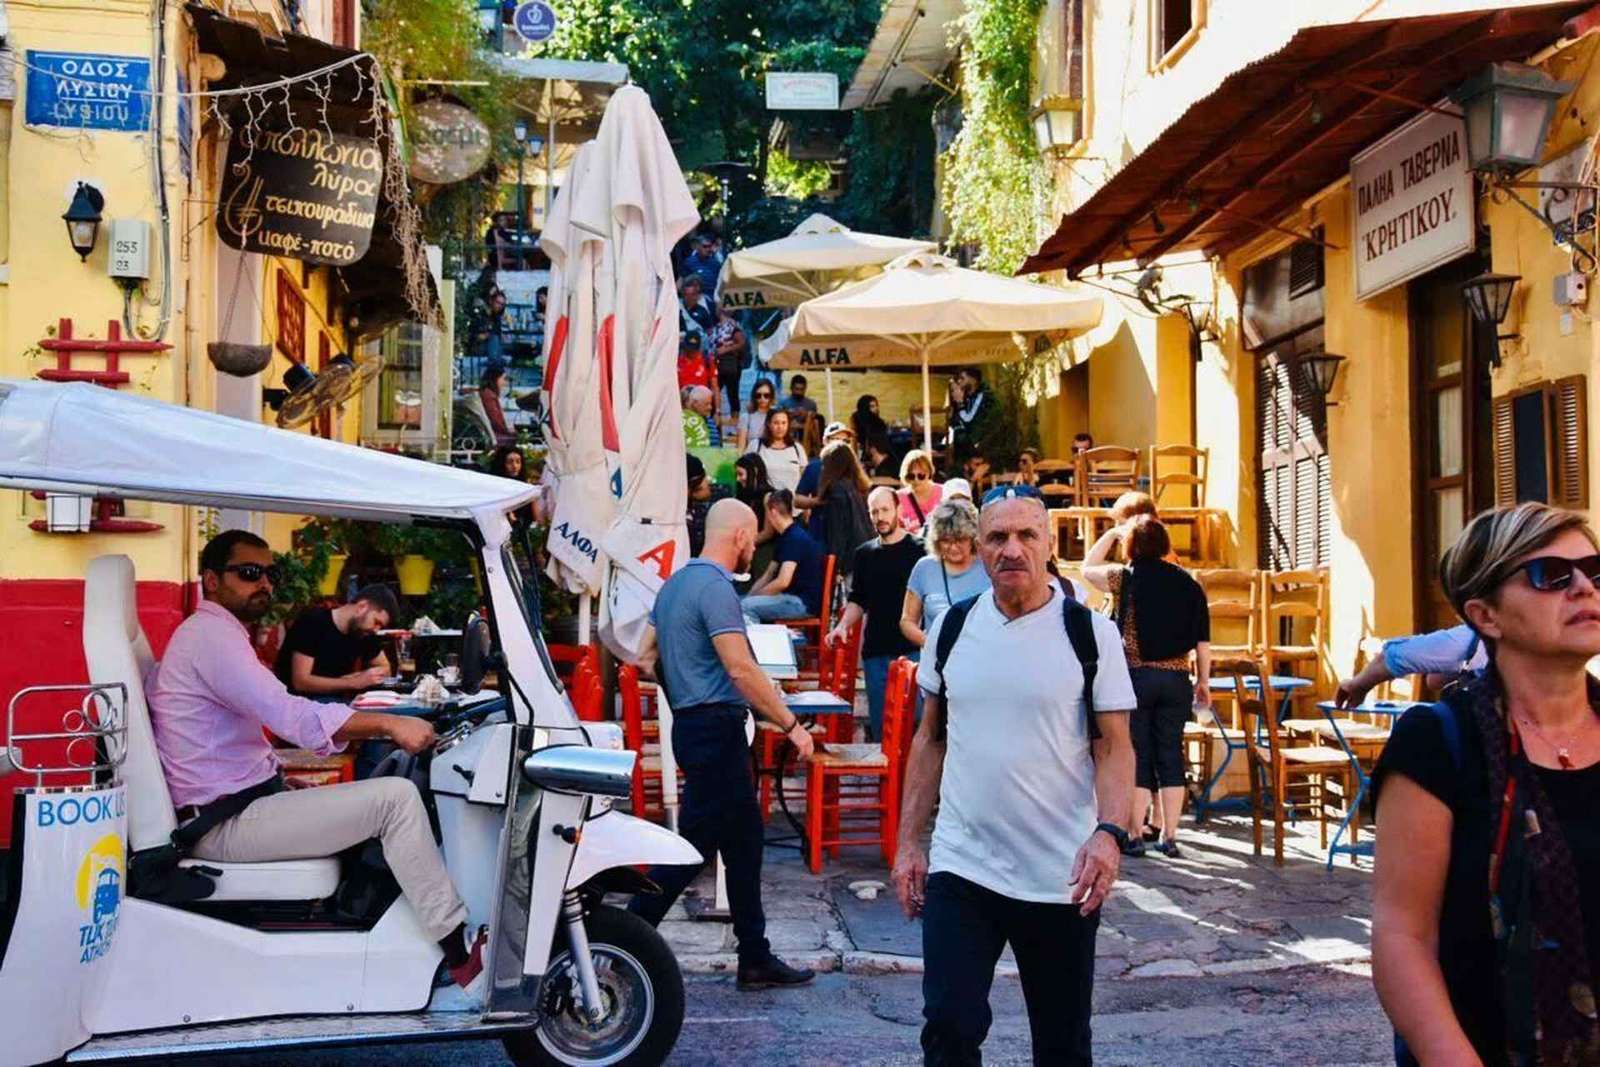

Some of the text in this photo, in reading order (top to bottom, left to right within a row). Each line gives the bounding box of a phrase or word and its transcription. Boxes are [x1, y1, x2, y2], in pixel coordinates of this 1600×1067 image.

[61, 60, 129, 78] ΟΔΟΣ
[56, 80, 133, 99] ΛΥΣΙΟΥ
[53, 103, 129, 121] LYSIOU
[1400, 131, 1460, 191] ΤΑΒΕΡΝΑ
[116, 240, 138, 254] 253
[722, 291, 766, 307] ALFA
[799, 347, 851, 366] ALFA
[553, 521, 599, 564] ΑΛΦΑ
[37, 796, 113, 827] BOOK
